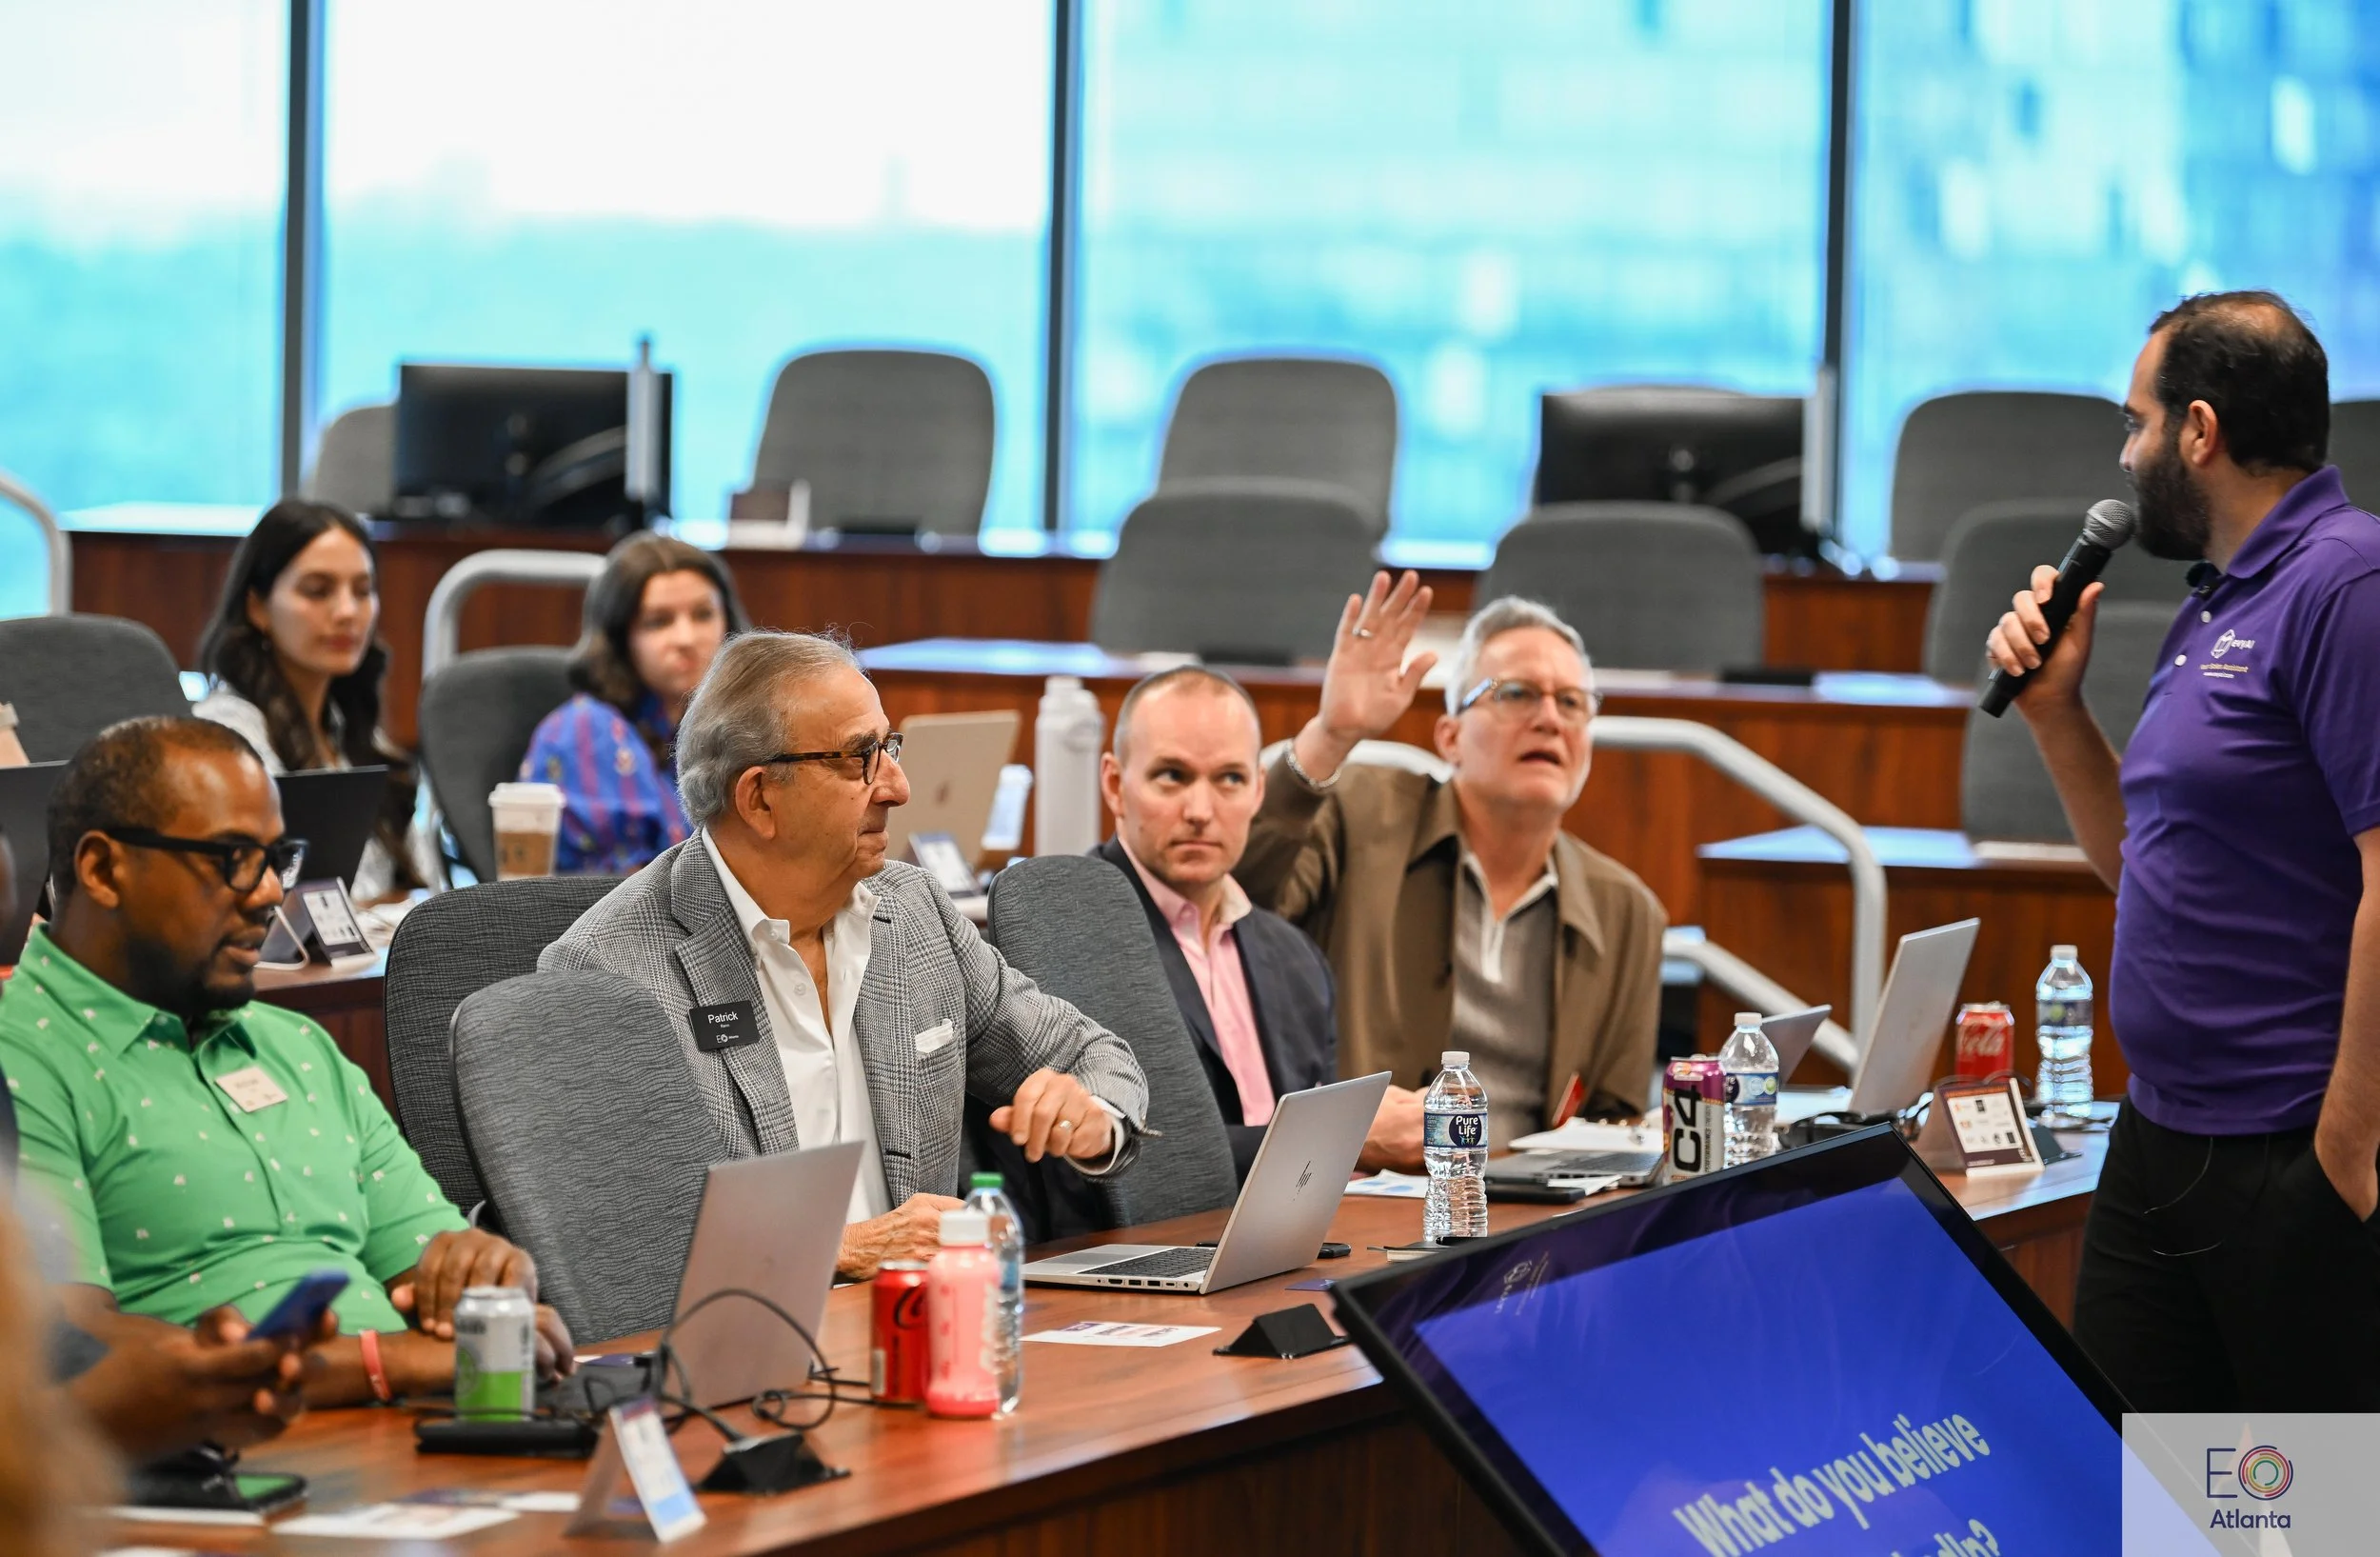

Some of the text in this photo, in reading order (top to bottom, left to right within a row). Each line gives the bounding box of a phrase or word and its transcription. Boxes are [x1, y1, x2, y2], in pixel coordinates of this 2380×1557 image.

[707, 1011, 739, 1024] Patrick
[1456, 1115, 1478, 1125] Pure
[1458, 1125, 1477, 1137] Life
[1674, 1084, 1702, 1172] C4
[1672, 1413, 1991, 1557] What do you believe
